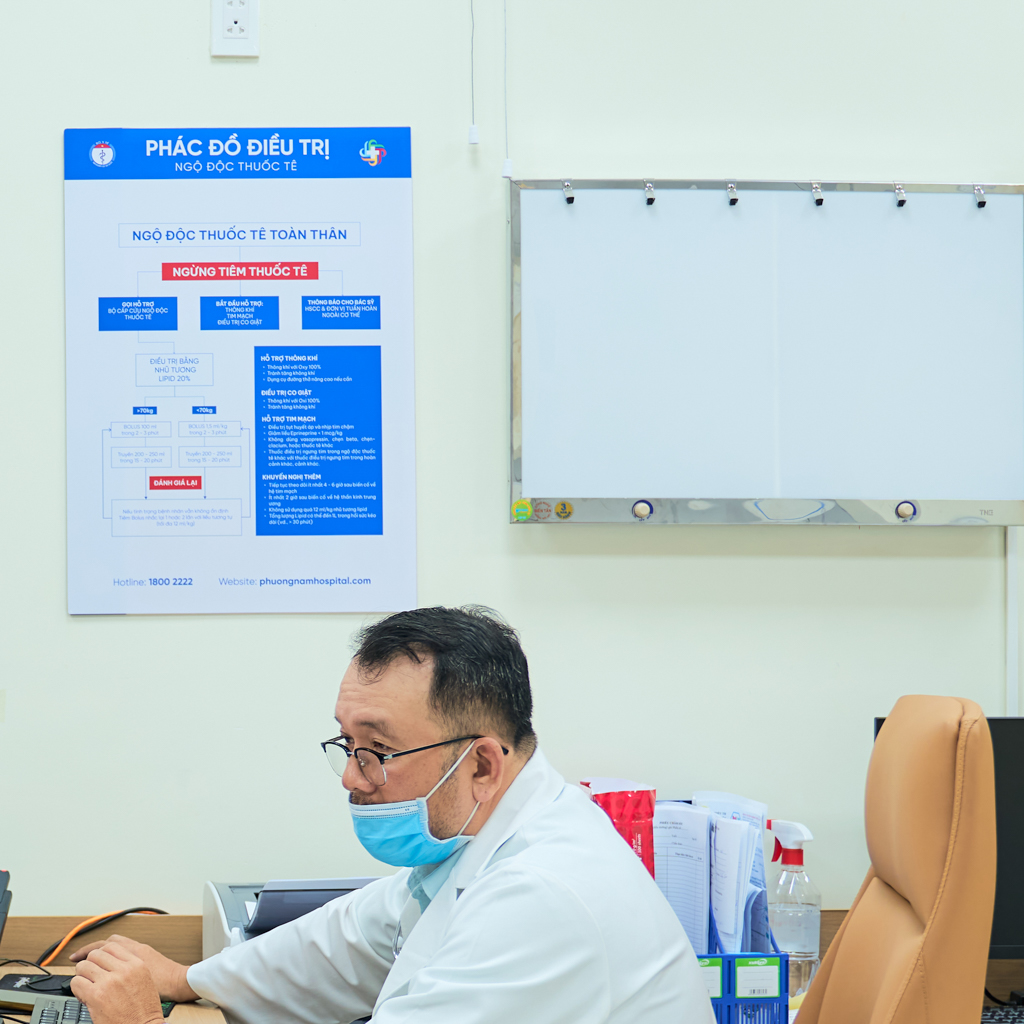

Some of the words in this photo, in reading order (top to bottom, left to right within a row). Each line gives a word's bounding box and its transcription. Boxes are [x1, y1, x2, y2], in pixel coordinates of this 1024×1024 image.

[146, 135, 202, 156] PHÁC
[209, 133, 241, 156] ĐỒ
[247, 133, 293, 156] ĐIỀU
[299, 138, 329, 160] TRỊ
[175, 160, 202, 173] NGỘ
[207, 160, 234, 173] ĐỘC
[238, 159, 280, 171] THUỐC
[284, 159, 297, 171] TÊ
[133, 228, 162, 243] NGỘ
[165, 228, 195, 243] ĐỘC
[200, 226, 246, 240] THUỐC
[251, 227, 266, 240] TÊ
[270, 227, 306, 240] TOÀN
[310, 227, 346, 240] THÂN
[173, 263, 216, 277] NGỪNG
[219, 264, 246, 276] TIÊM
[249, 263, 290, 276] THUỐC
[293, 264, 307, 276] TÊ
[114, 577, 146, 586] Hotline:
[149, 578, 170, 586] 1800
[173, 577, 193, 586] 2222
[219, 576, 257, 586] Website:
[259, 576, 371, 587] phuongnamhospital.com
